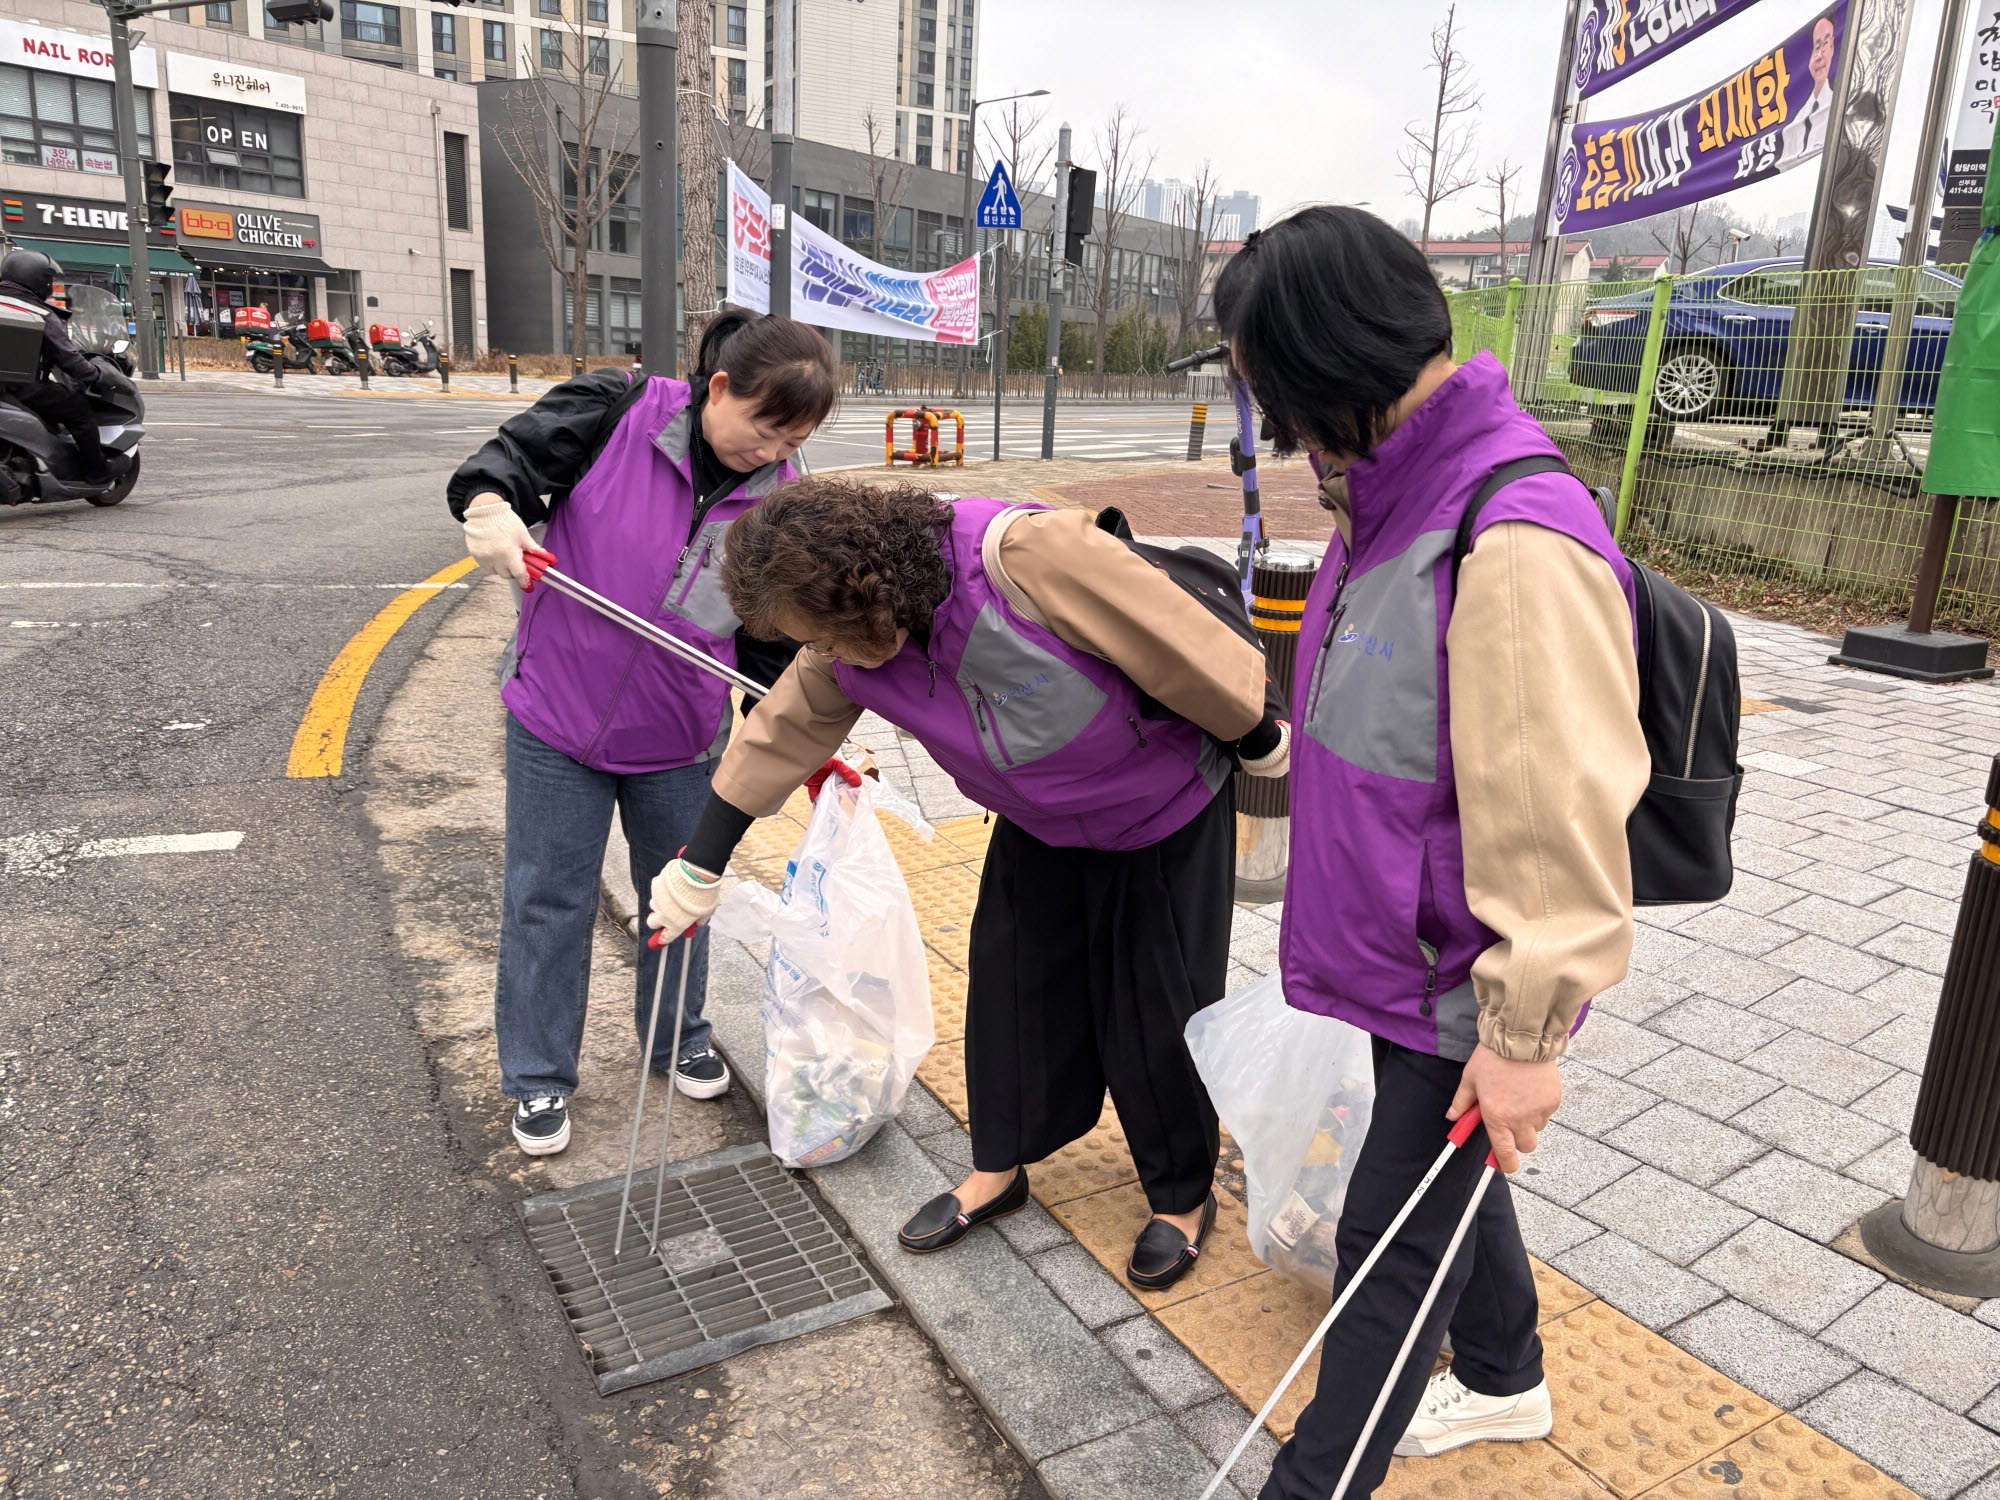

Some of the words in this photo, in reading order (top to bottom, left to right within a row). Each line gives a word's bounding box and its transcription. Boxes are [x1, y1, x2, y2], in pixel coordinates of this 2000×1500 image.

[23, 37, 71, 61] NAIL
[211, 72, 271, 93] 유니진헤어
[36, 203, 129, 231] 7-ELEVE
[236, 213, 283, 232] OLIVE
[983, 214, 1017, 226] 횡단보도
[238, 229, 303, 249] CHICKEN
